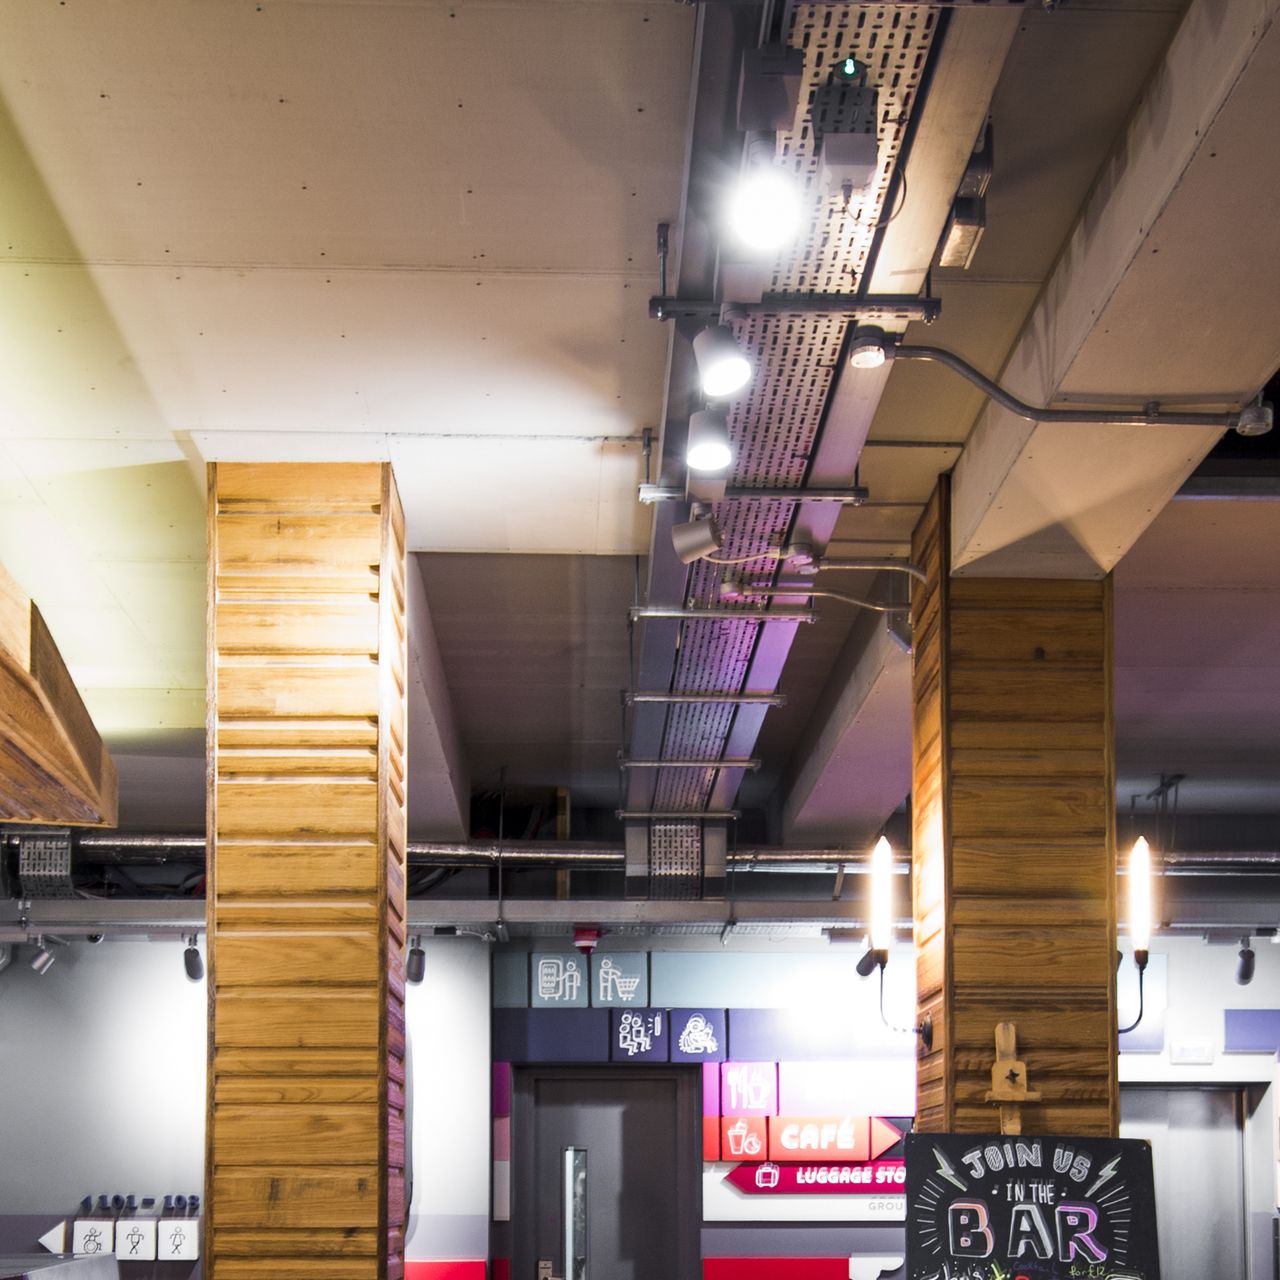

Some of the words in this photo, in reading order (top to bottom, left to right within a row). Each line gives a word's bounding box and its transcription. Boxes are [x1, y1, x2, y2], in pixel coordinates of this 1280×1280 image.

[780, 1115, 855, 1150] CAFÉ
[796, 1167, 872, 1184] LUGGAGE
[961, 1143, 1042, 1179] JOIN
[1053, 1148, 1091, 1183] US
[98, 1194, 138, 1209] 101
[1006, 1184, 1024, 1201] IN
[1029, 1184, 1055, 1205] THE
[948, 1201, 1108, 1263] BAR
